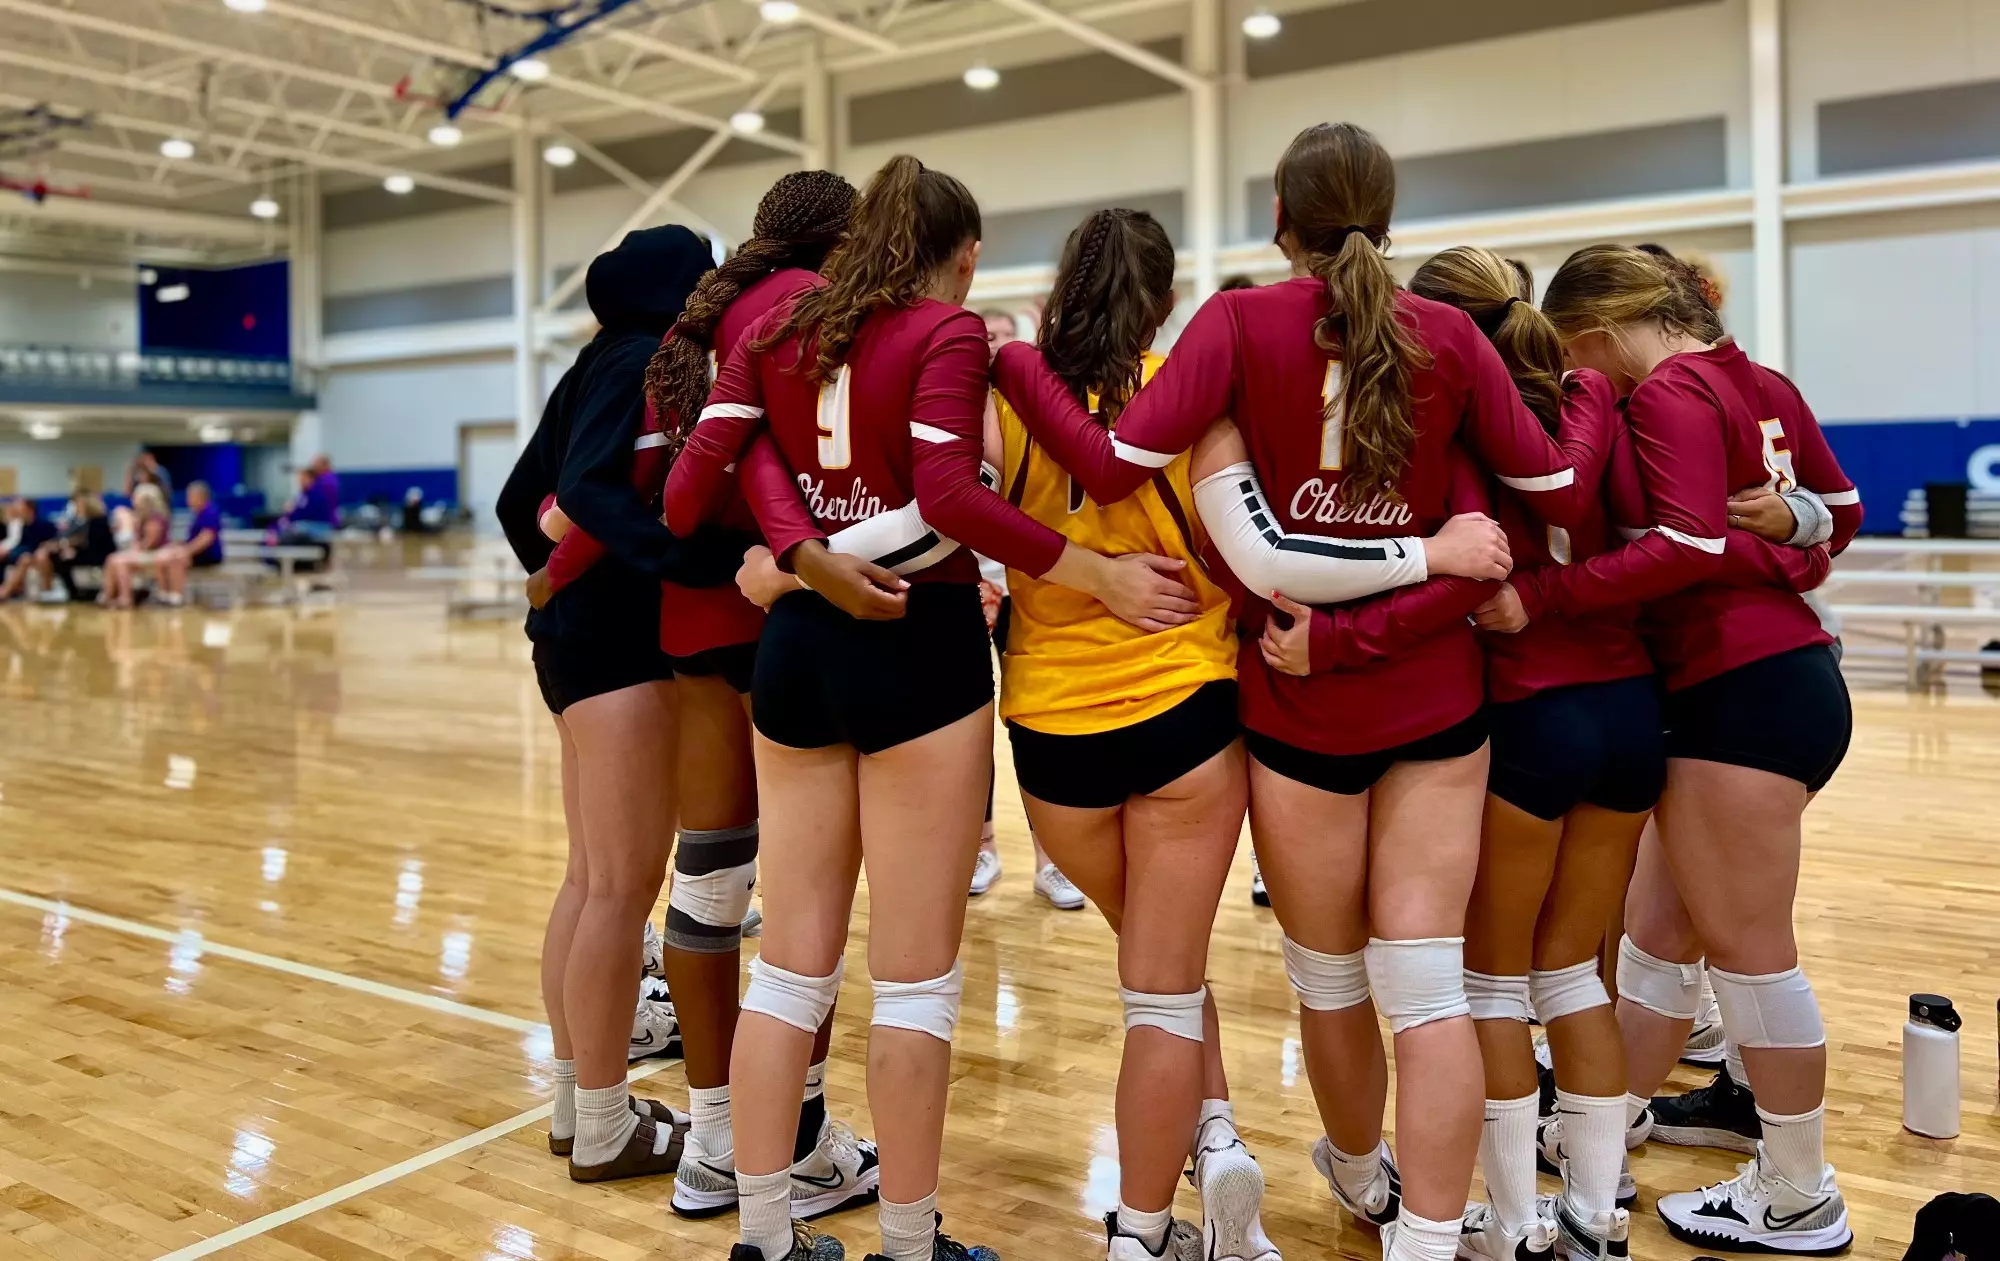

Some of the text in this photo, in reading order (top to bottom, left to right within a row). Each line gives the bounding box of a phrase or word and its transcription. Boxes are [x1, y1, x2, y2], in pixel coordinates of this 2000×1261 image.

[816, 363, 851, 470] 9
[1758, 417, 1797, 494] 5
[1290, 477, 1413, 526] Oberlin
